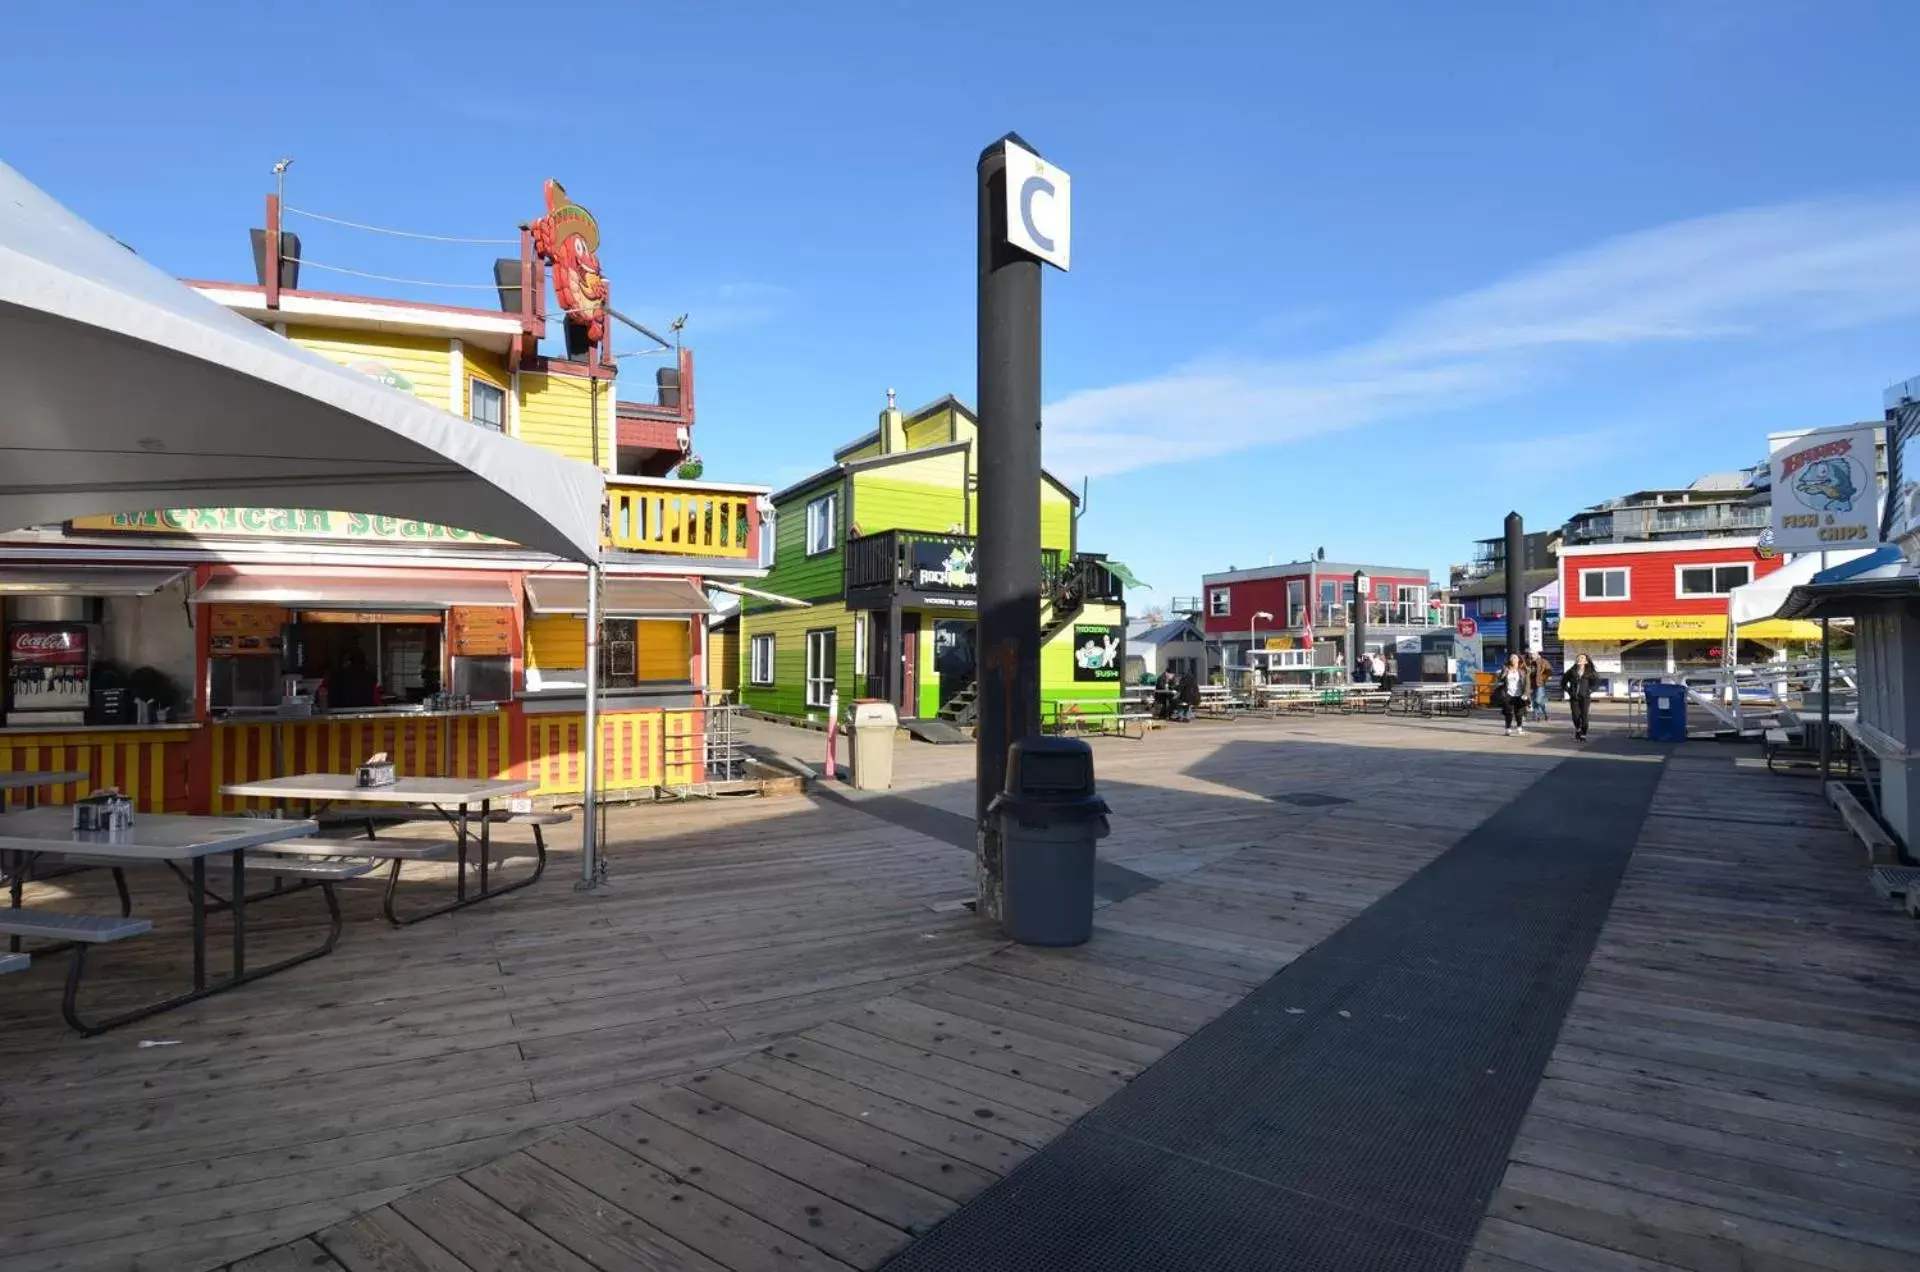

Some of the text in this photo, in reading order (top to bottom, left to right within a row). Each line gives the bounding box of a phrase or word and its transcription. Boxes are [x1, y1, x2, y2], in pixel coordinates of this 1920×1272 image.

[1020, 176, 1055, 252] C
[1783, 514, 1818, 529] FISH
[1817, 524, 1869, 541] CHIPS
